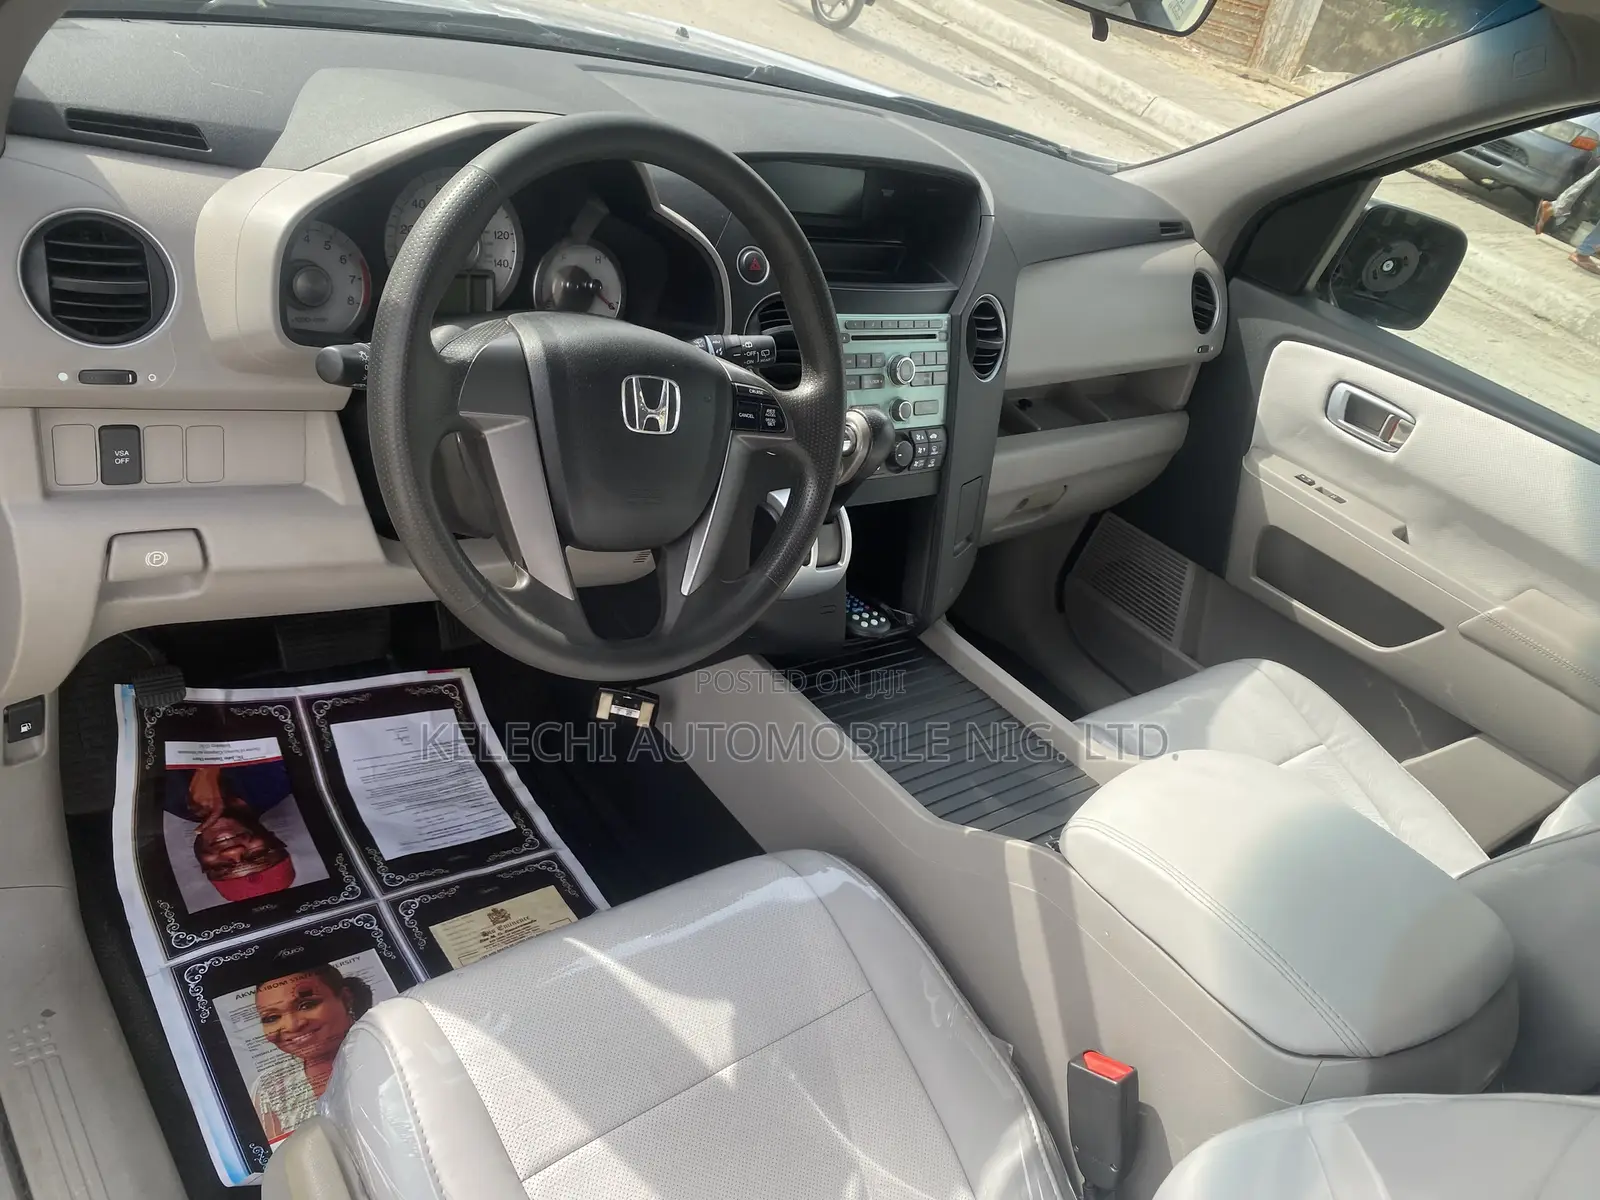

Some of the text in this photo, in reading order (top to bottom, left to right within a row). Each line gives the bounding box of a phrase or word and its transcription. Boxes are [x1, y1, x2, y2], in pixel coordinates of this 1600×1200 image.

[411, 198, 427, 209] 40
[303, 235, 311, 244] 4
[494, 230, 510, 240] 120
[323, 240, 332, 251] 5
[340, 255, 348, 265] 6
[494, 259, 510, 268] 140
[595, 255, 602, 264] H
[348, 274, 356, 284] 7
[347, 296, 355, 306] 8
[114, 449, 130, 457] VSA
[114, 457, 130, 465] OFF
[263, 980, 288, 991] IBOM
